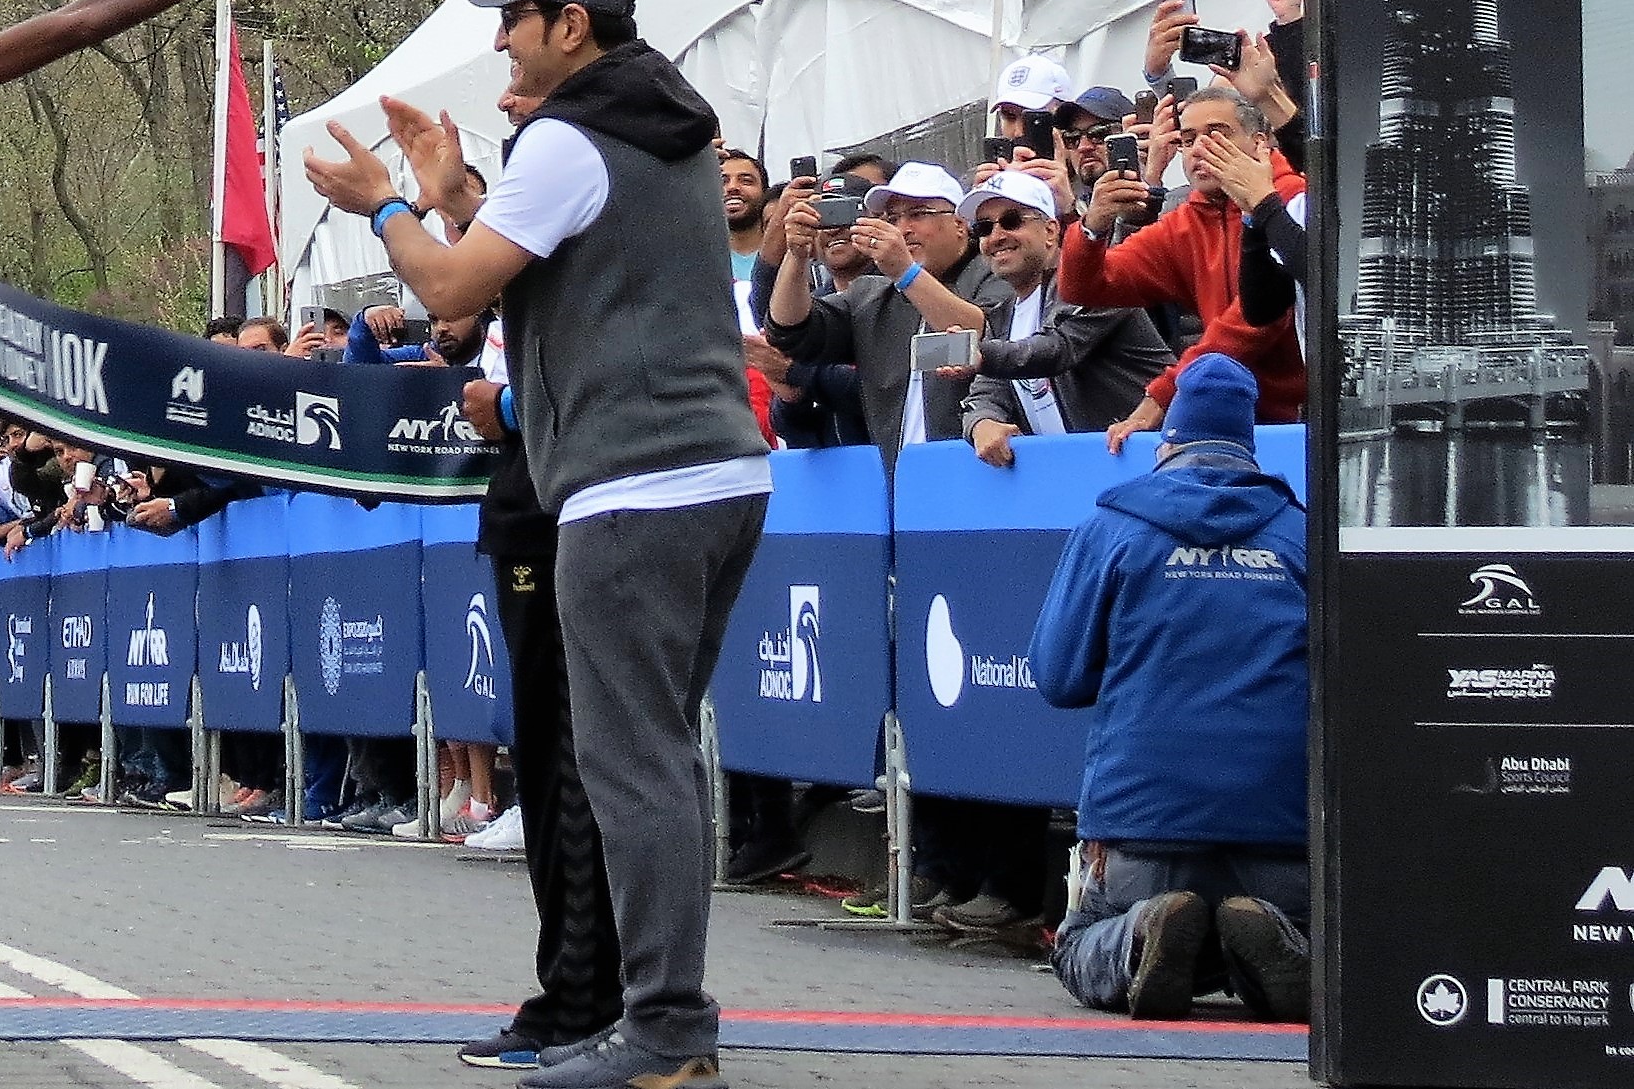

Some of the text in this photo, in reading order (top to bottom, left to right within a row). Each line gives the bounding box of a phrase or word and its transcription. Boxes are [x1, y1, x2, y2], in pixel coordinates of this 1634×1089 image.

[434, 446, 461, 455] ROAD
[1485, 598, 1540, 609] GAL
[971, 655, 1016, 689] National
[473, 675, 497, 700] GAL
[759, 669, 792, 701] ADNOC
[1501, 757, 1570, 771] Abu Dhabi
[1573, 924, 1623, 942] NEW
[1508, 978, 1610, 994] CENTRAL PARK
[1508, 993, 1609, 1009] CONSERVANCY
[1508, 1013, 1610, 1027] central to the park
